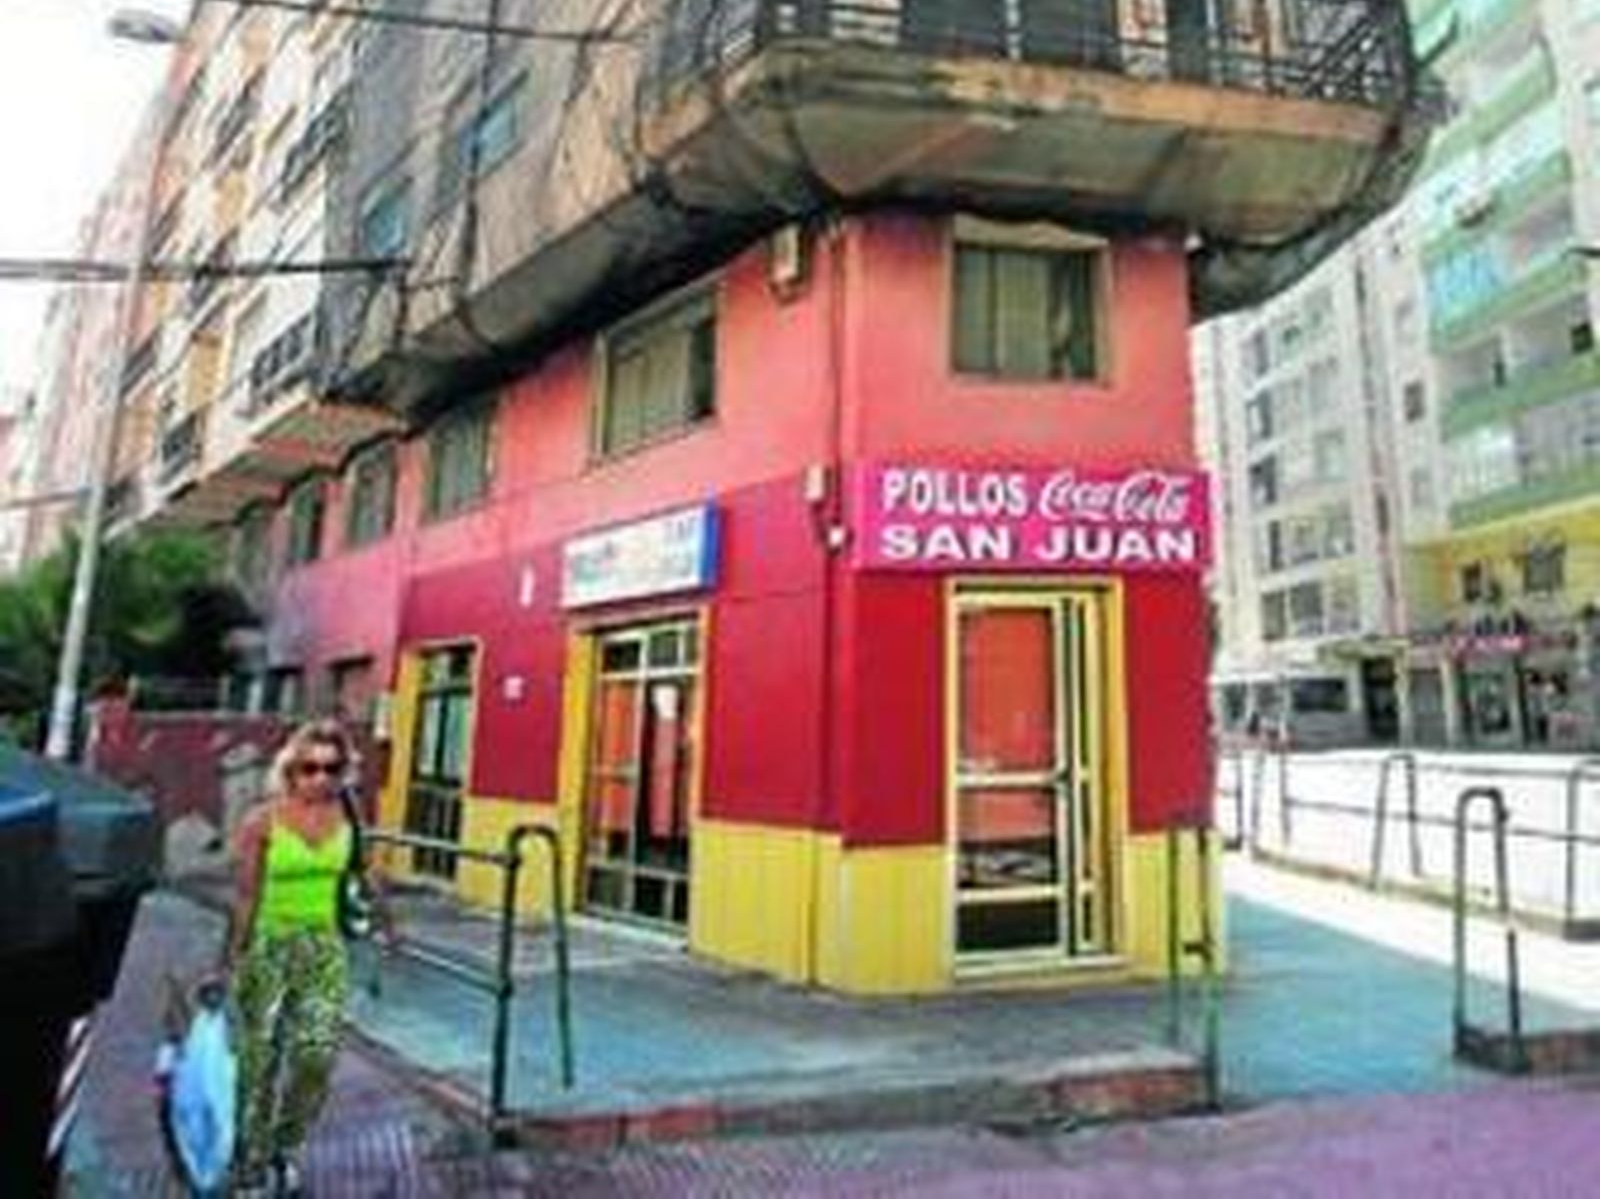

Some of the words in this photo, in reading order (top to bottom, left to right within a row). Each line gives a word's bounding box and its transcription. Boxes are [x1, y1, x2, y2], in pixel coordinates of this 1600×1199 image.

[883, 470, 1026, 515] POLLOS
[880, 524, 1010, 560] SAN
[1036, 526, 1196, 561] JUAN
